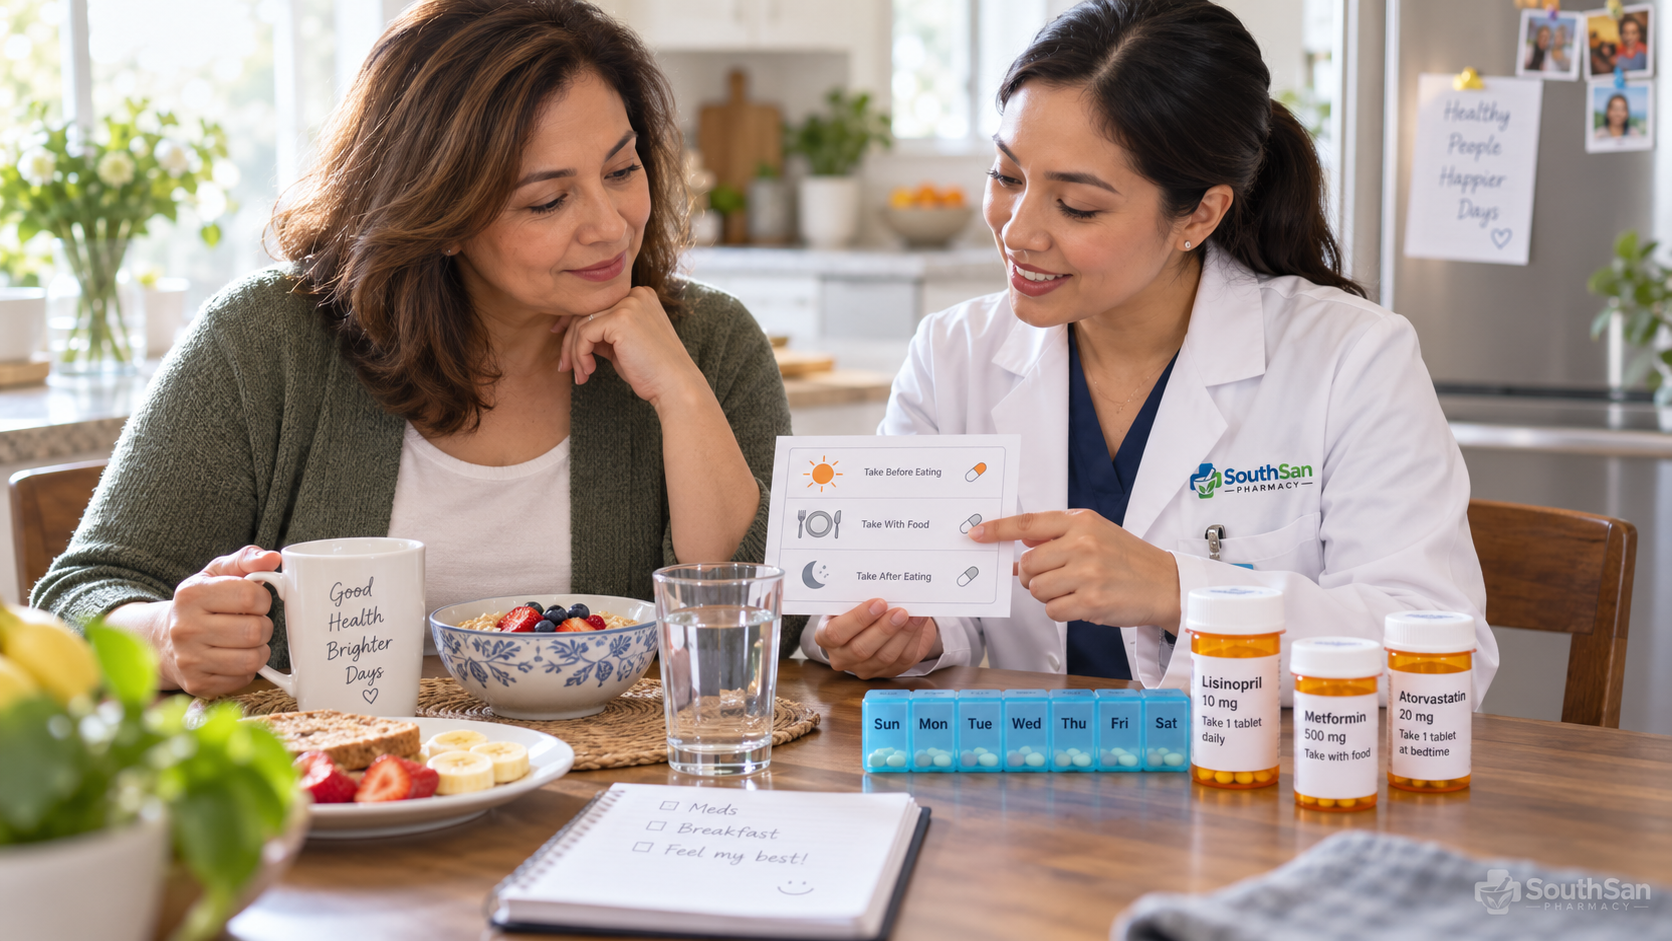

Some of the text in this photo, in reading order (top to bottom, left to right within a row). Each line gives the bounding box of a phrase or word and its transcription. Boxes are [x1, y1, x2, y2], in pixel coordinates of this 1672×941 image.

[1444, 99, 1511, 132] Healthy
[1447, 131, 1502, 162] People
[1439, 165, 1507, 194] Happier
[1457, 198, 1499, 229] Days
[864, 468, 942, 478] Take Before Eating
[1224, 463, 1313, 485] SouthSan
[1236, 482, 1299, 493] PHARMACY
[862, 520, 930, 529] Take With Food
[856, 572, 932, 583] Take After Eating
[329, 576, 374, 607] Good
[328, 606, 384, 632] Health
[326, 635, 393, 662] Brighter
[345, 665, 384, 686] Days
[1202, 675, 1262, 694] Lisinopril
[1202, 695, 1238, 711] 10 mg
[1399, 690, 1466, 705] Atorvastatin
[874, 718, 900, 730] Sun
[919, 718, 948, 730] Mon
[968, 718, 992, 730] Tue
[1012, 717, 1041, 730] Wed
[1061, 717, 1086, 730] Thu
[1111, 717, 1129, 730] Fri
[1155, 717, 1177, 730] Sat
[1202, 716, 1262, 729] Take 1 tablet
[1304, 710, 1367, 725] Metformin
[1399, 709, 1434, 725] 20 mg
[1202, 732, 1225, 746] daily
[1304, 729, 1346, 745] 500 mg
[1399, 729, 1456, 742] Take 1 tablet
[1304, 748, 1371, 762] Take with food
[1399, 745, 1450, 757] at bedtime
[688, 803, 739, 816] Meds
[677, 822, 780, 840] Breakfast
[664, 843, 809, 866] Feel my best!
